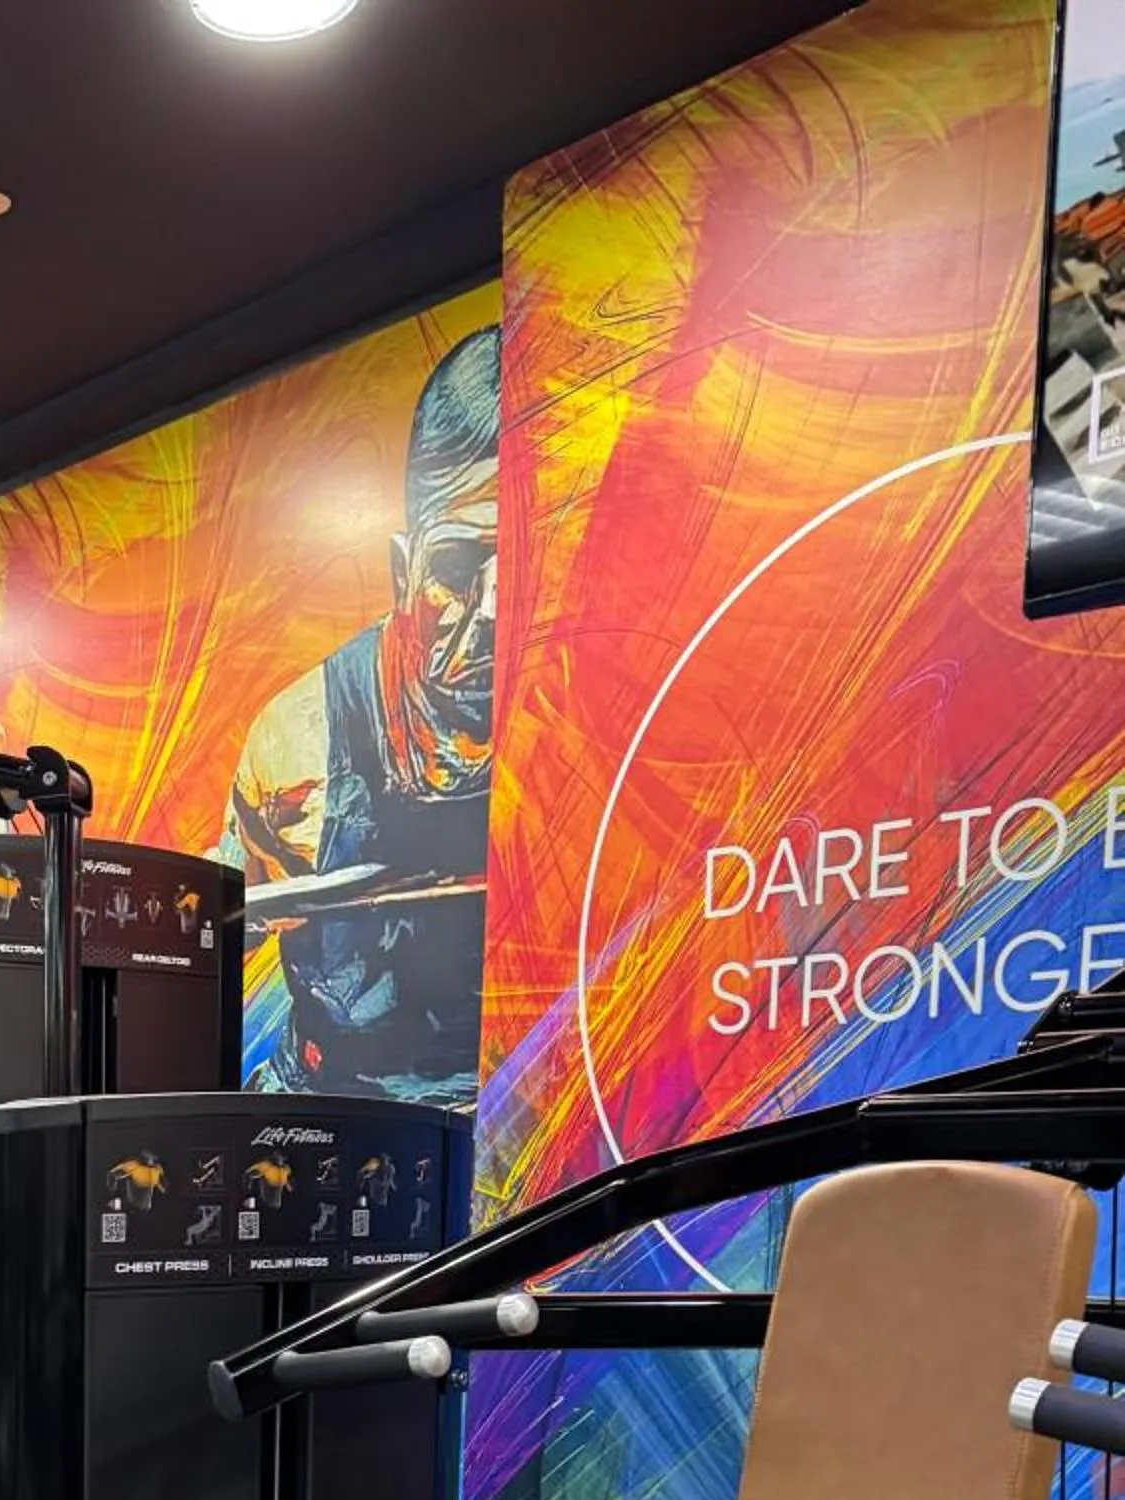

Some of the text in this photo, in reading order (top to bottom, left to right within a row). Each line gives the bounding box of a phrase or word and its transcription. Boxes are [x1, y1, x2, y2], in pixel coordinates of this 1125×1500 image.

[703, 818, 914, 920] DARE
[940, 798, 1068, 888] TO
[250, 1126, 335, 1147] Life Fitness
[115, 1259, 210, 1273] CHEST PRESS
[249, 1257, 329, 1270] INCLINE PRESS
